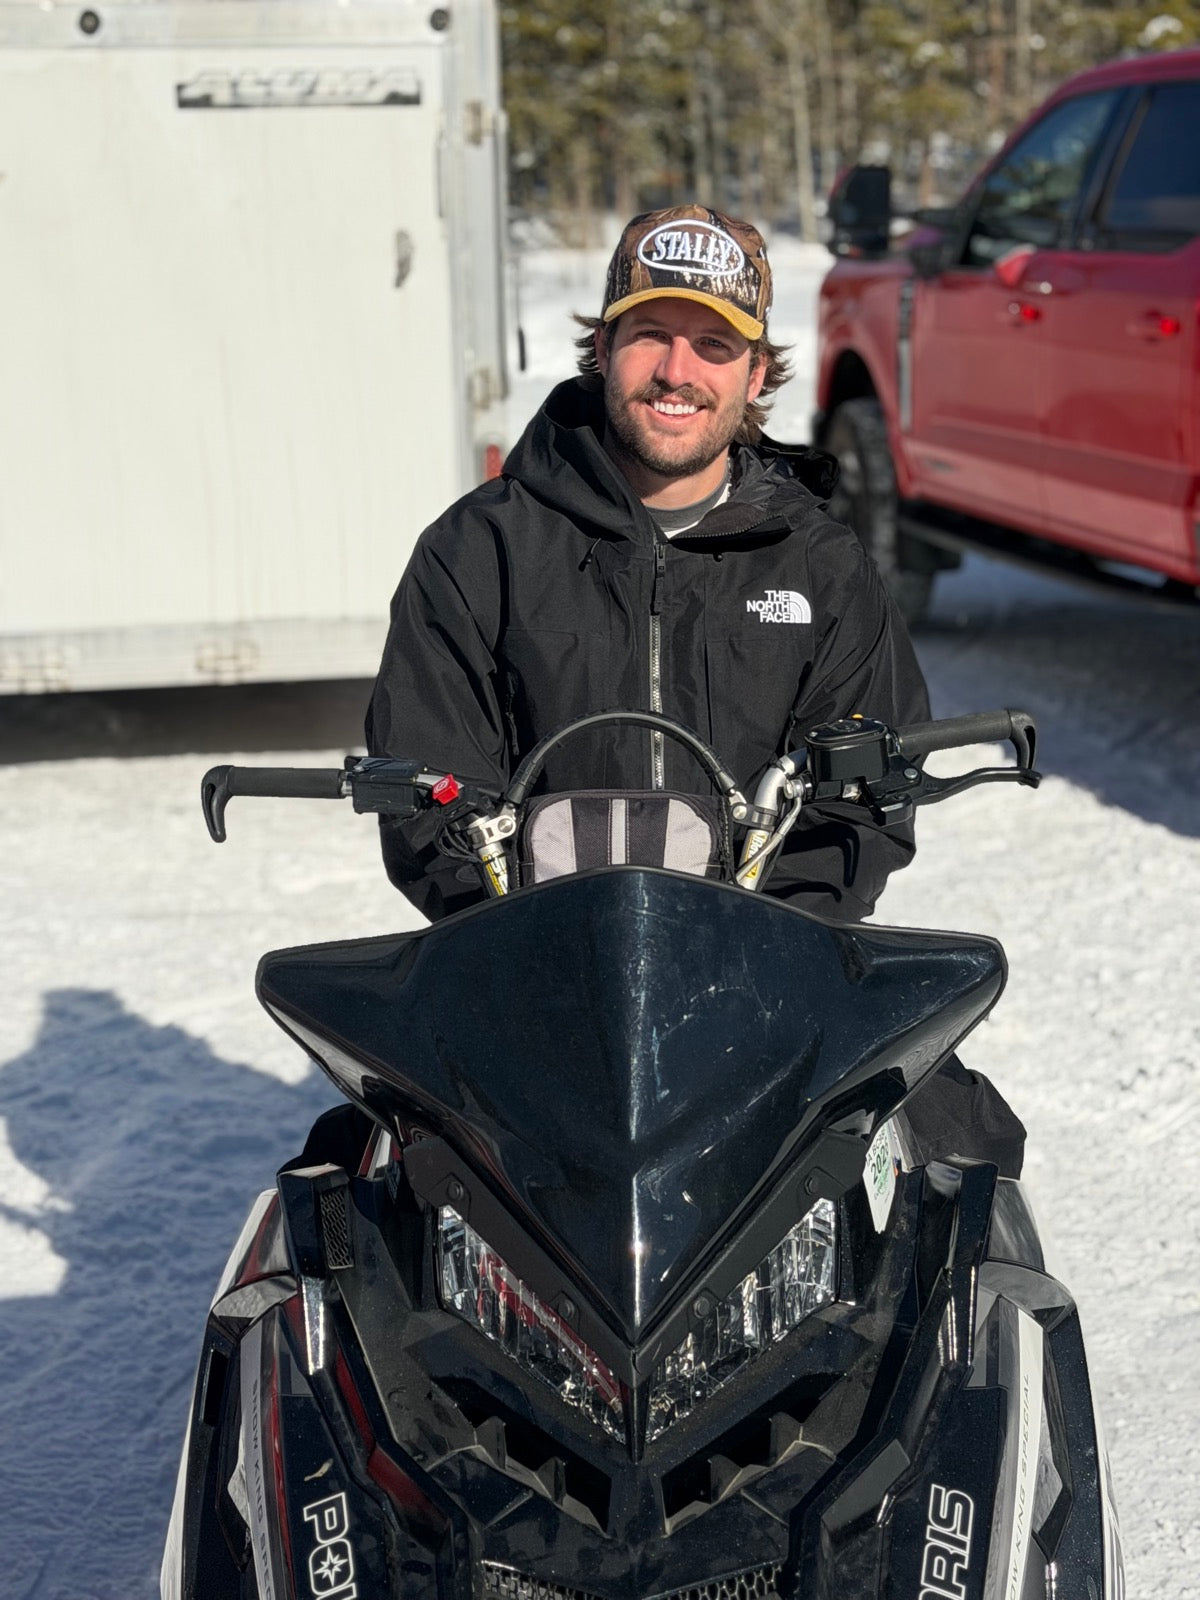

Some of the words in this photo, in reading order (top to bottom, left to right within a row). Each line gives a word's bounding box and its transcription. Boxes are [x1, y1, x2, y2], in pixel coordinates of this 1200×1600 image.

[180, 68, 421, 104] ALUMA
[652, 231, 733, 268] STALLY
[746, 600, 790, 612] NORTH
[764, 590, 789, 601] THE
[760, 612, 790, 623] FACE
[1020, 1374, 1029, 1478] SPECIAL
[254, 1459, 264, 1524] KING
[1015, 1483, 1026, 1553] KING
